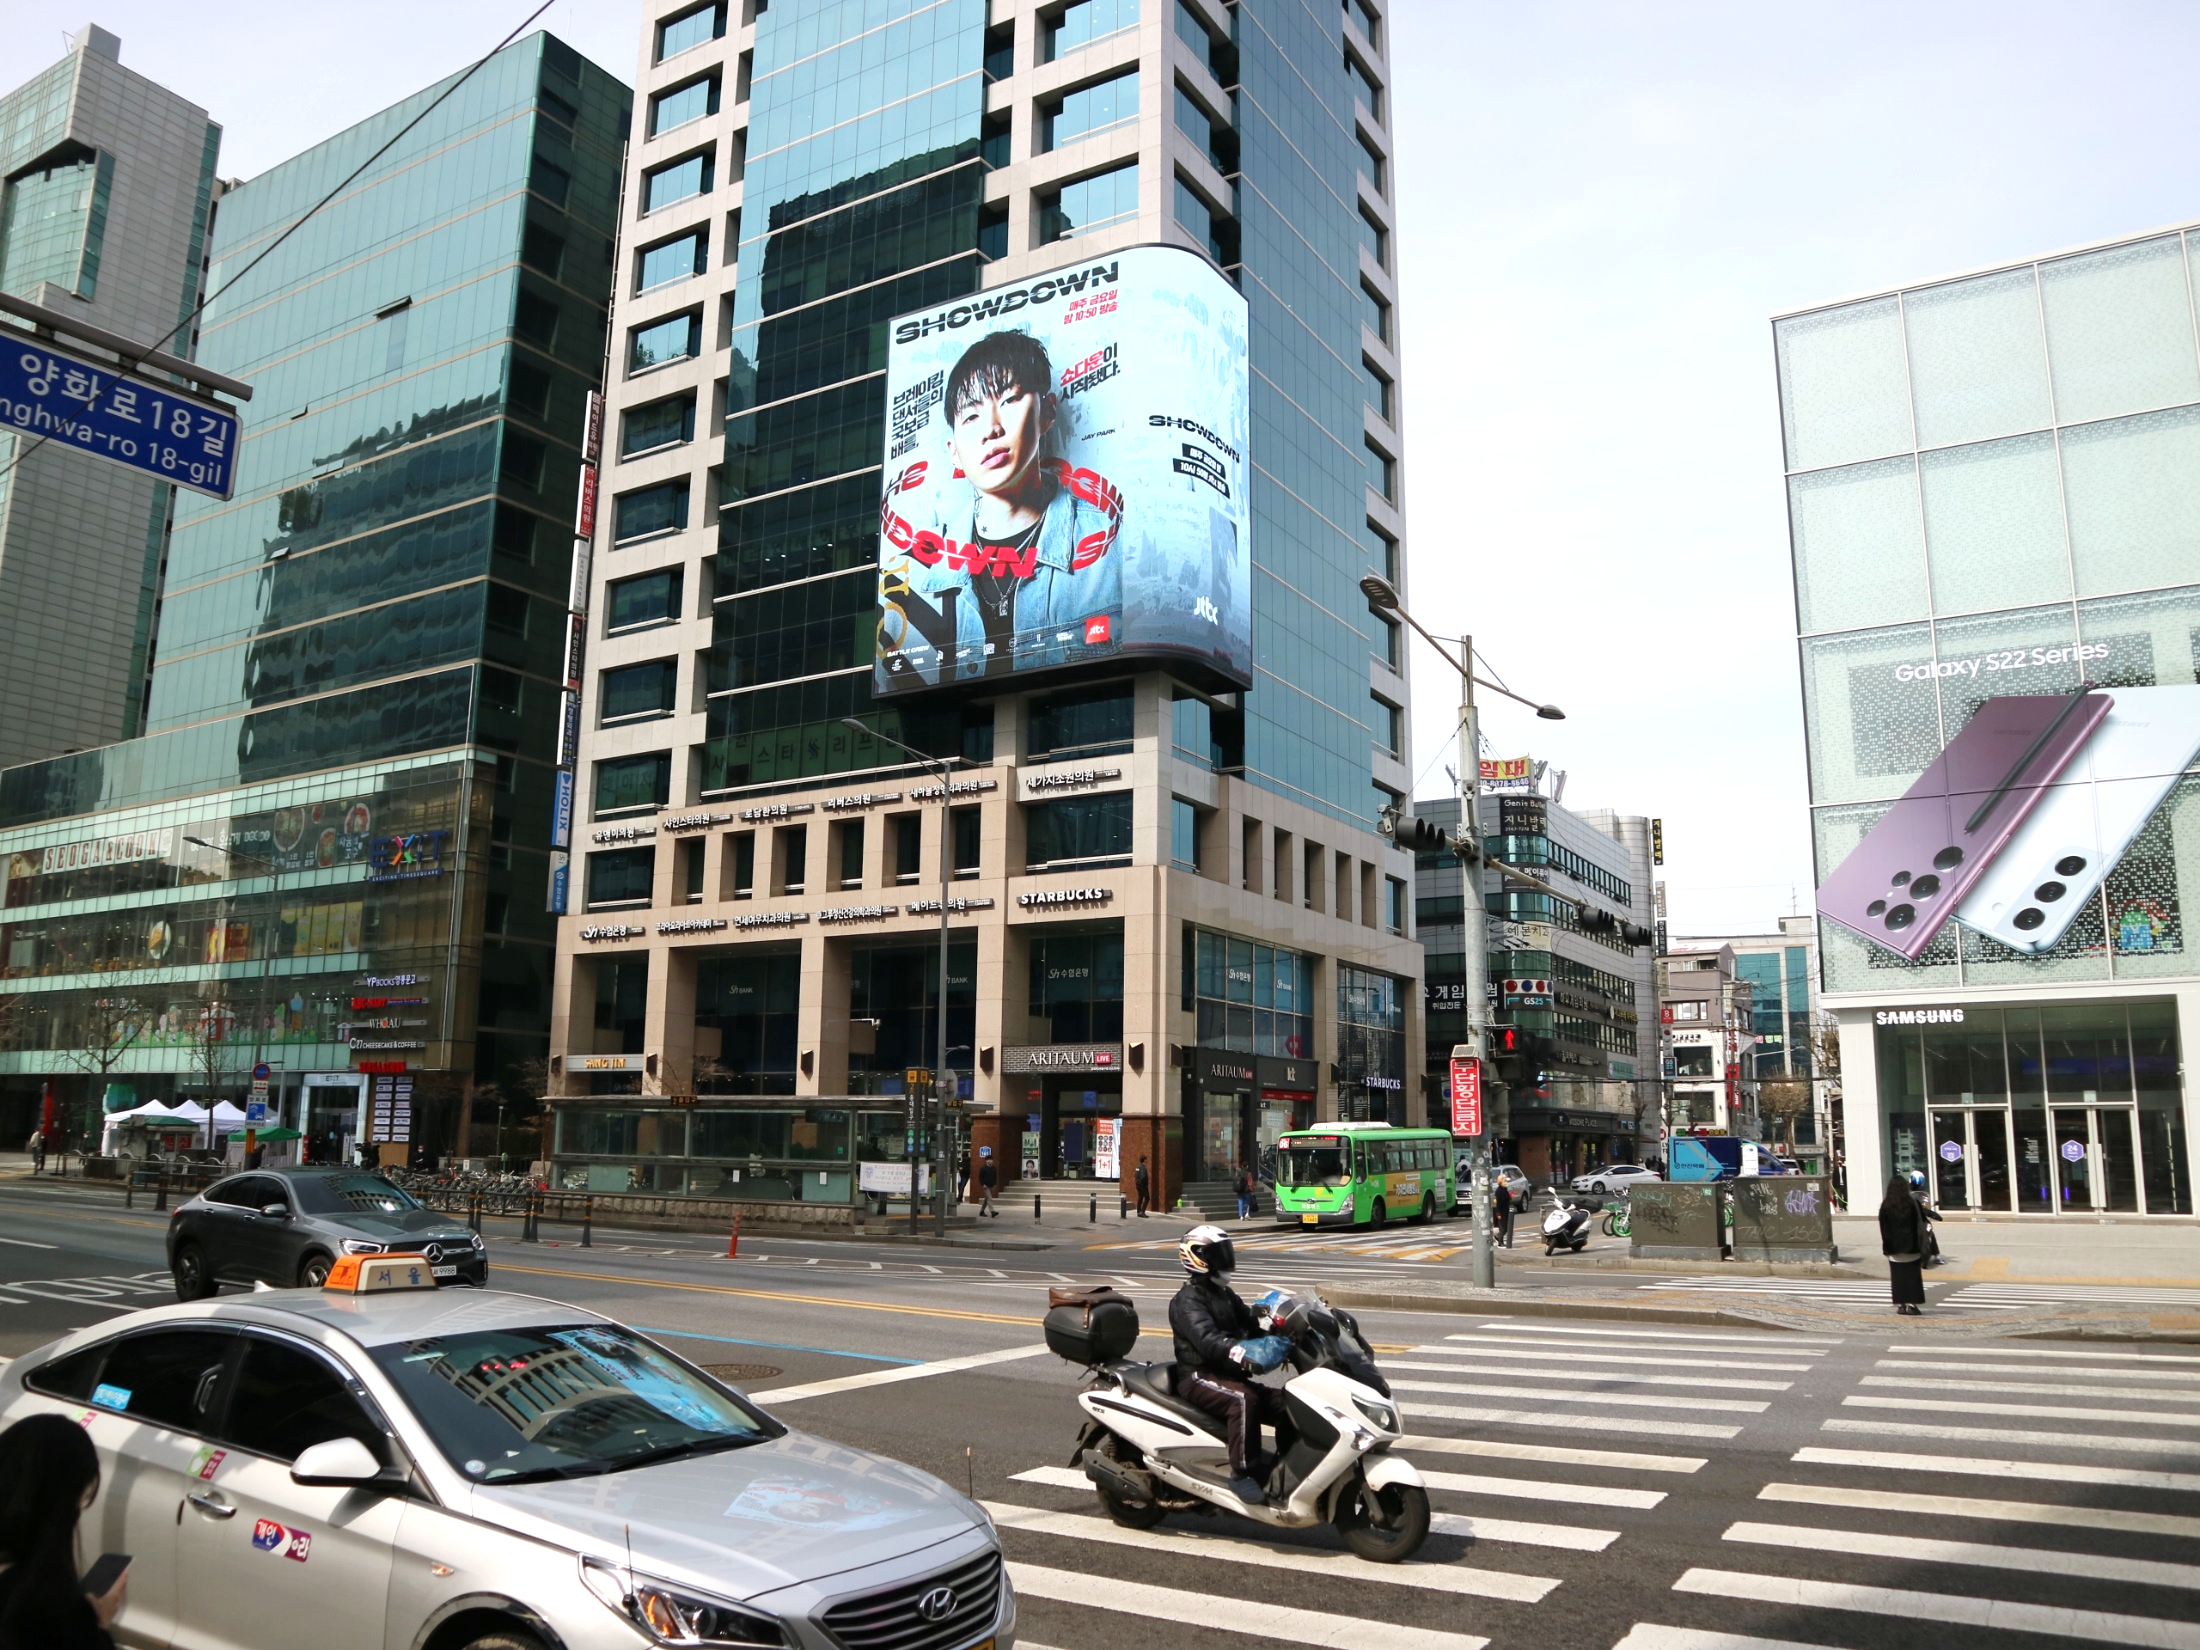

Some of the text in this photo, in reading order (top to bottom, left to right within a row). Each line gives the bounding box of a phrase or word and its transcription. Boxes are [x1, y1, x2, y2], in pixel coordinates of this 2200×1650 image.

[896, 261, 1118, 344] SHOWDOWN
[1069, 288, 1118, 312] 매주 금요일
[1075, 306, 1097, 321] 10:50
[1099, 301, 1118, 315] 방송
[1060, 342, 1118, 387] 쇼다운이
[893, 370, 944, 411] 브레이킹
[892, 386, 943, 428] 댄서들의
[892, 410, 930, 441] 국보급
[1081, 427, 1116, 441] JAY PARK
[1148, 415, 1240, 463] SHOWDOWN
[149, 442, 222, 485] 18-gil
[1194, 595, 1218, 626] jtbc
[1090, 624, 1105, 636] jtbc
[887, 644, 930, 658] BATTLE CREW
[1895, 641, 2110, 683] Galaxy S22 Series
[1479, 760, 1526, 778] 임대
[1026, 769, 1095, 788] 세가지소원의원
[828, 793, 872, 808] 리버스의원
[558, 786, 570, 831] HOLIX
[744, 804, 789, 819] 로담한의원
[594, 826, 635, 841] 유앤미의원
[370, 830, 449, 868] EXIT
[372, 873, 398, 882] EXCITING
[1021, 888, 1103, 905] STARBUCKS
[735, 911, 791, 926] 연세여우치과의원
[585, 925, 598, 938] Sh
[600, 925, 627, 937] 수협은행
[951, 976, 968, 984] BANK
[1061, 967, 1089, 978] 수협은행
[1435, 985, 1465, 999] 게임
[1432, 1002, 1461, 1010] 취업전문
[1524, 997, 1544, 1006] GS25
[1876, 1008, 1964, 1025] SAMSUNG
[611, 1058, 626, 1069] JIN
[1028, 1052, 1110, 1065] ARITAUM LIVE
[1211, 1064, 1245, 1078] ARITAUM
[1287, 1067, 1296, 1081] kt
[1366, 1076, 1400, 1089] STARBUCKS
[1453, 1061, 1476, 1134] 무단횡단금지
[1279, 1141, 1288, 1149] 06
[1098, 1159, 1111, 1170] 1+1
[378, 1267, 421, 1285] 서울
[1190, 1482, 1213, 1496] SYM
[257, 1521, 278, 1546] 개인
